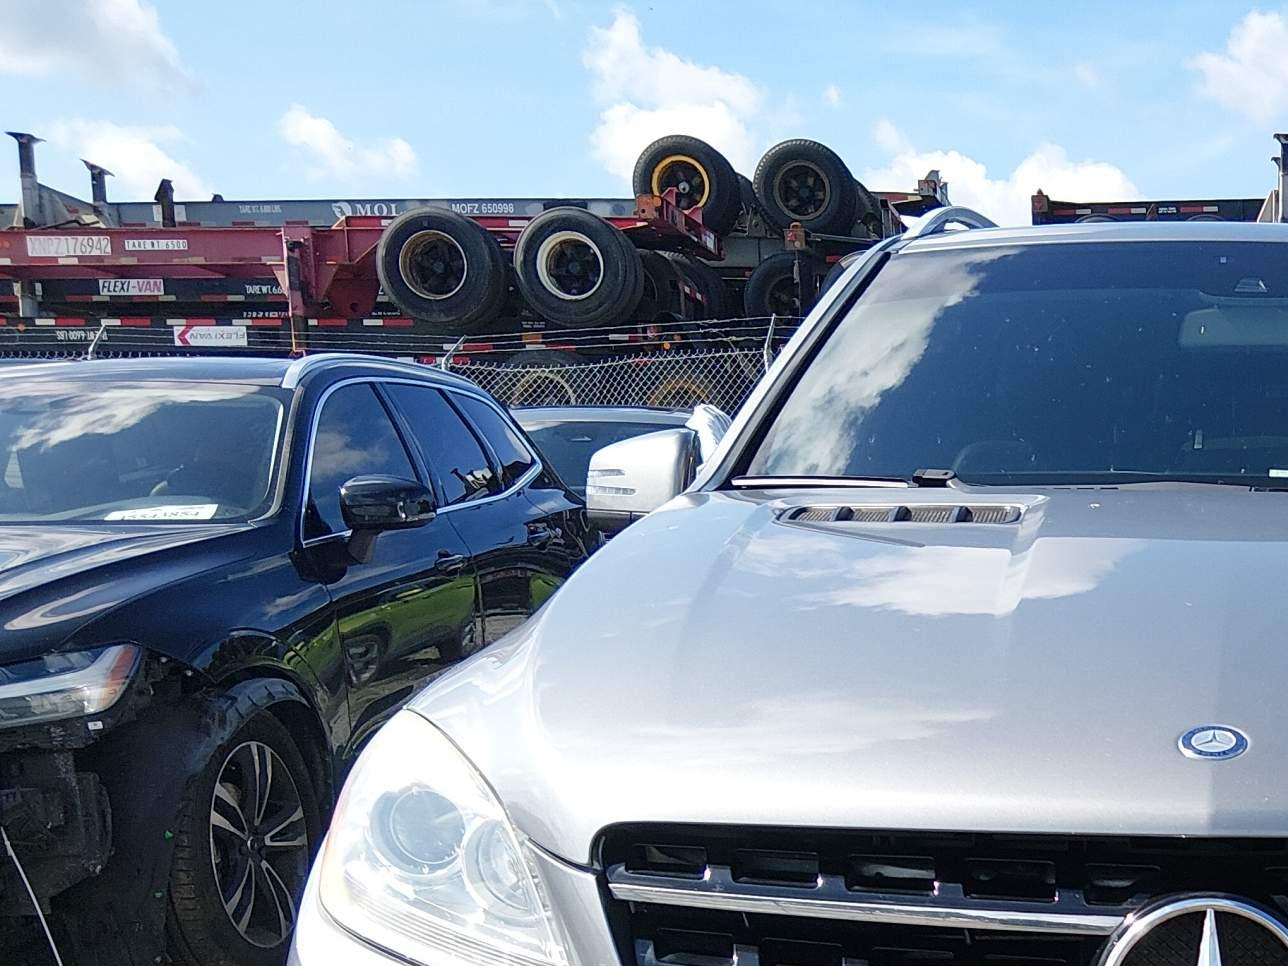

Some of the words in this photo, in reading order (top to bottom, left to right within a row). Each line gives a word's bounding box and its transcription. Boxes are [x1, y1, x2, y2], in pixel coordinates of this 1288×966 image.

[356, 203, 402, 216] MOL
[452, 203, 479, 214] MOFZ
[482, 203, 514, 214] 650998
[165, 240, 187, 249] 6500
[101, 280, 162, 294] FLEXI-VAN
